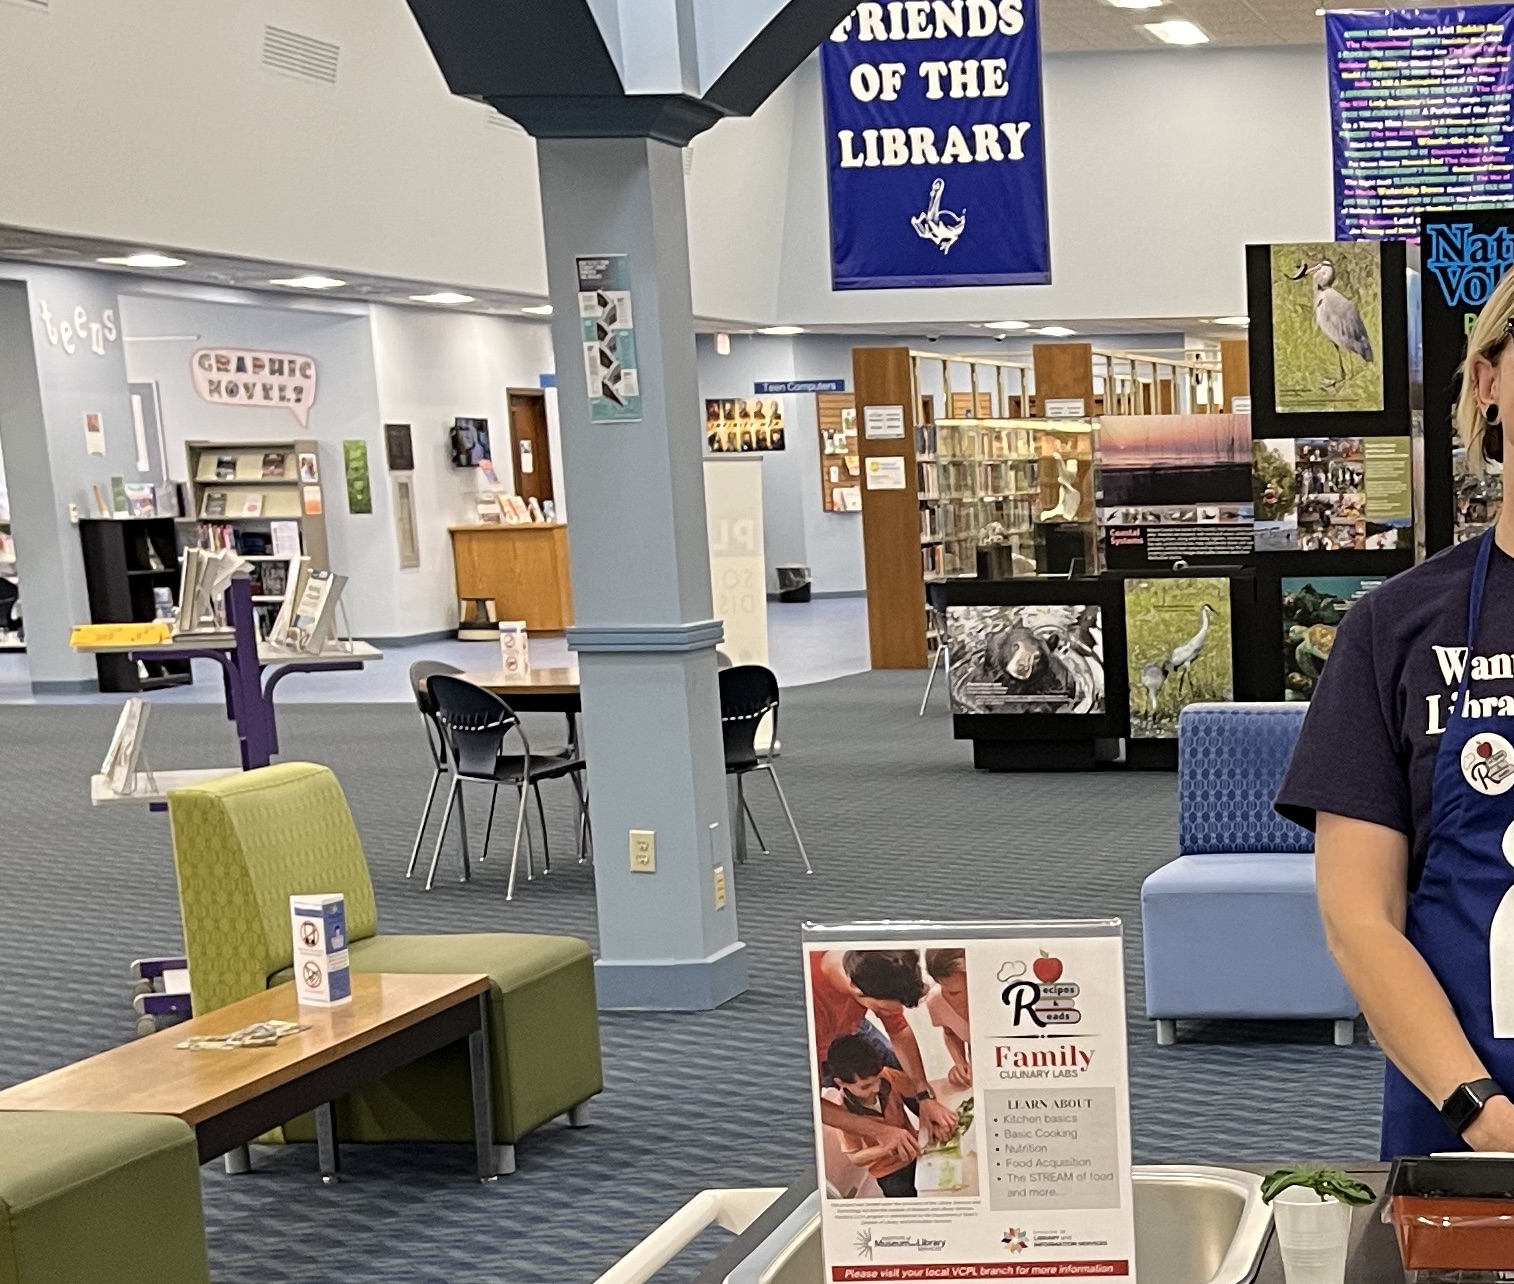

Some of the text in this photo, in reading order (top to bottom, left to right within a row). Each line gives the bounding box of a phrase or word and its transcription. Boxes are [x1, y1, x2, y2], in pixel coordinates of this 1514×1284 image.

[850, 58, 1009, 102] OF THE
[837, 122, 1031, 168] LIBRARY
[40, 301, 117, 355] teens
[198, 353, 313, 380] GRAPHIC
[763, 382, 837, 393] Teen Computers
[1110, 528, 1140, 537] Coastal
[1110, 537, 1144, 546] Systems
[995, 1045, 1095, 1071] Family
[1000, 1070, 1078, 1079] CULINARY LABS
[1008, 1099, 1093, 1109] LEARN ABOUT
[1004, 1115, 1077, 1123] Kitchen basics
[1004, 1129, 1077, 1139] Basic Cooking
[1005, 1144, 1047, 1153] Nutrition
[1006, 1158, 1091, 1169] Food Acquisition
[1008, 1172, 1113, 1182] The STREAM of food
[1008, 1189, 1026, 1197] and
[845, 1264, 1113, 1278] Please visit your local VCPL branch for more information
